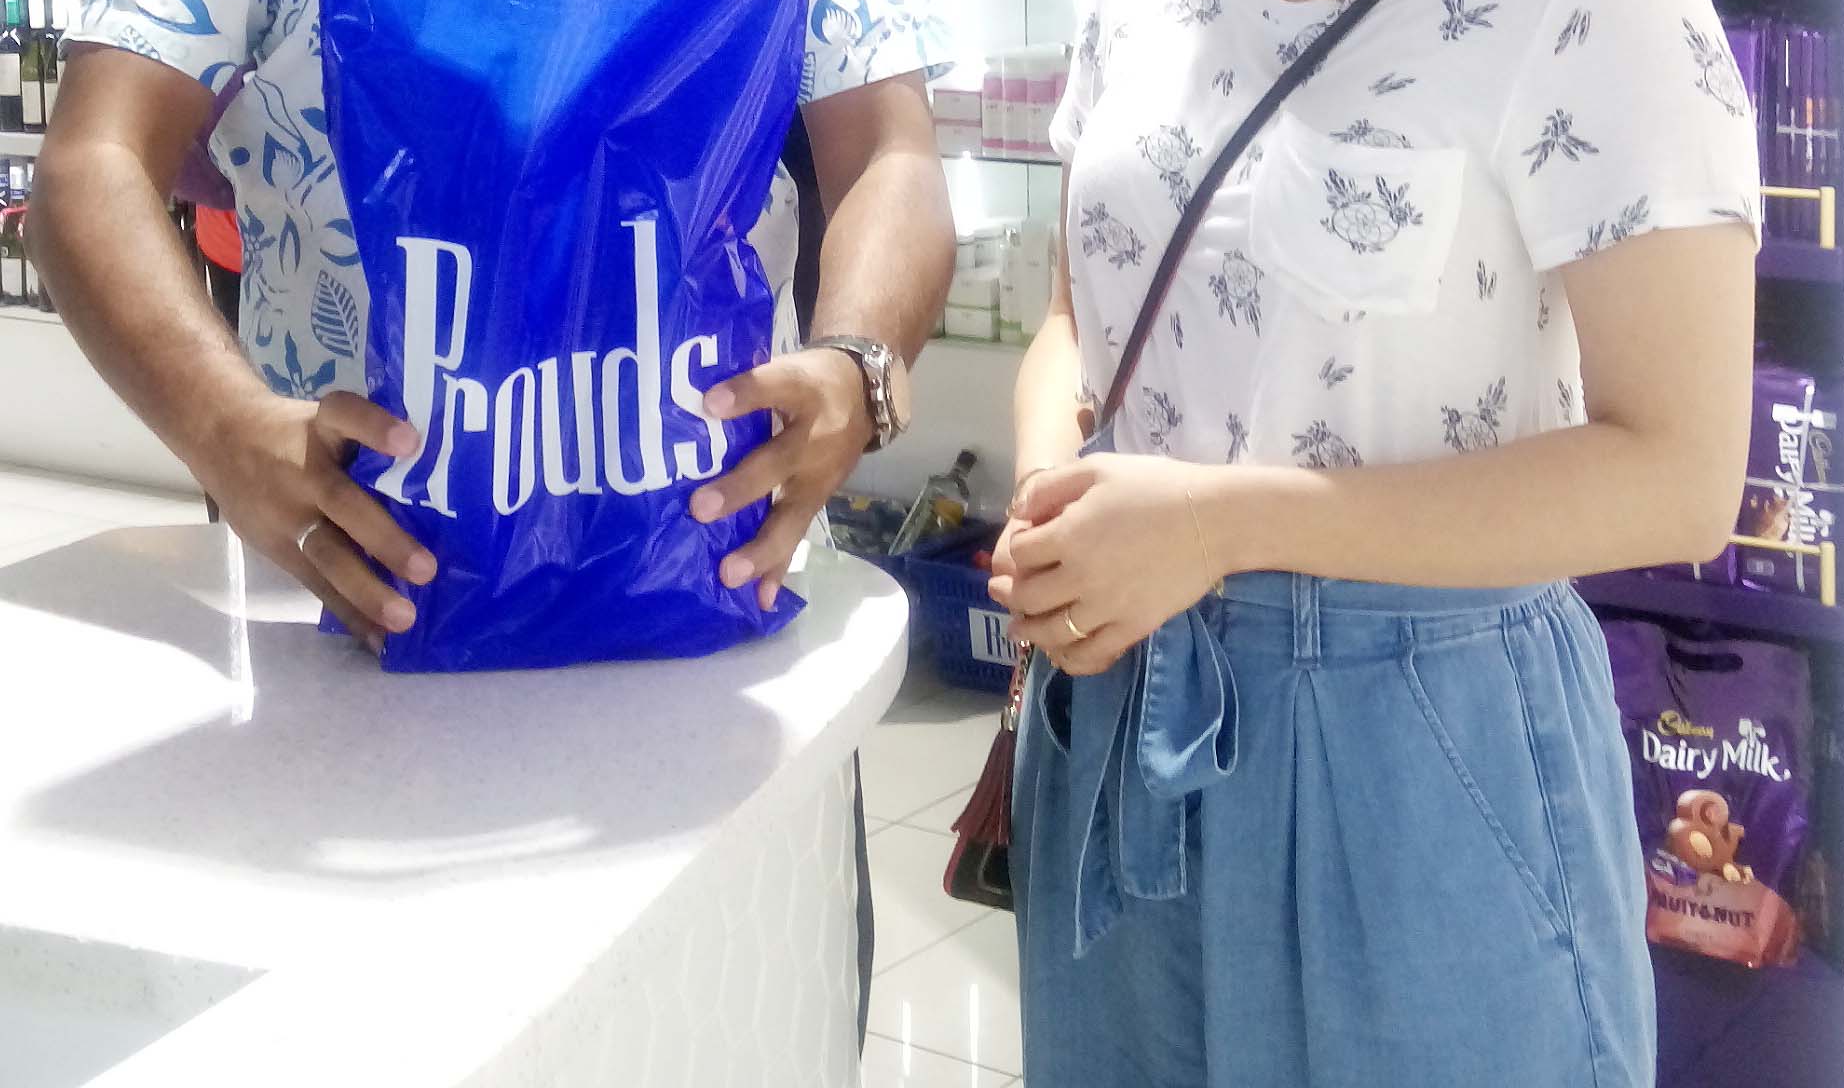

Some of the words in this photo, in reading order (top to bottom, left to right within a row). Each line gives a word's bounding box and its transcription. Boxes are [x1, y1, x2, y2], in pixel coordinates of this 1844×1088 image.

[374, 209, 728, 519] Prouds
[1642, 728, 1718, 780] Dairy
[1721, 718, 1784, 783] Milk
